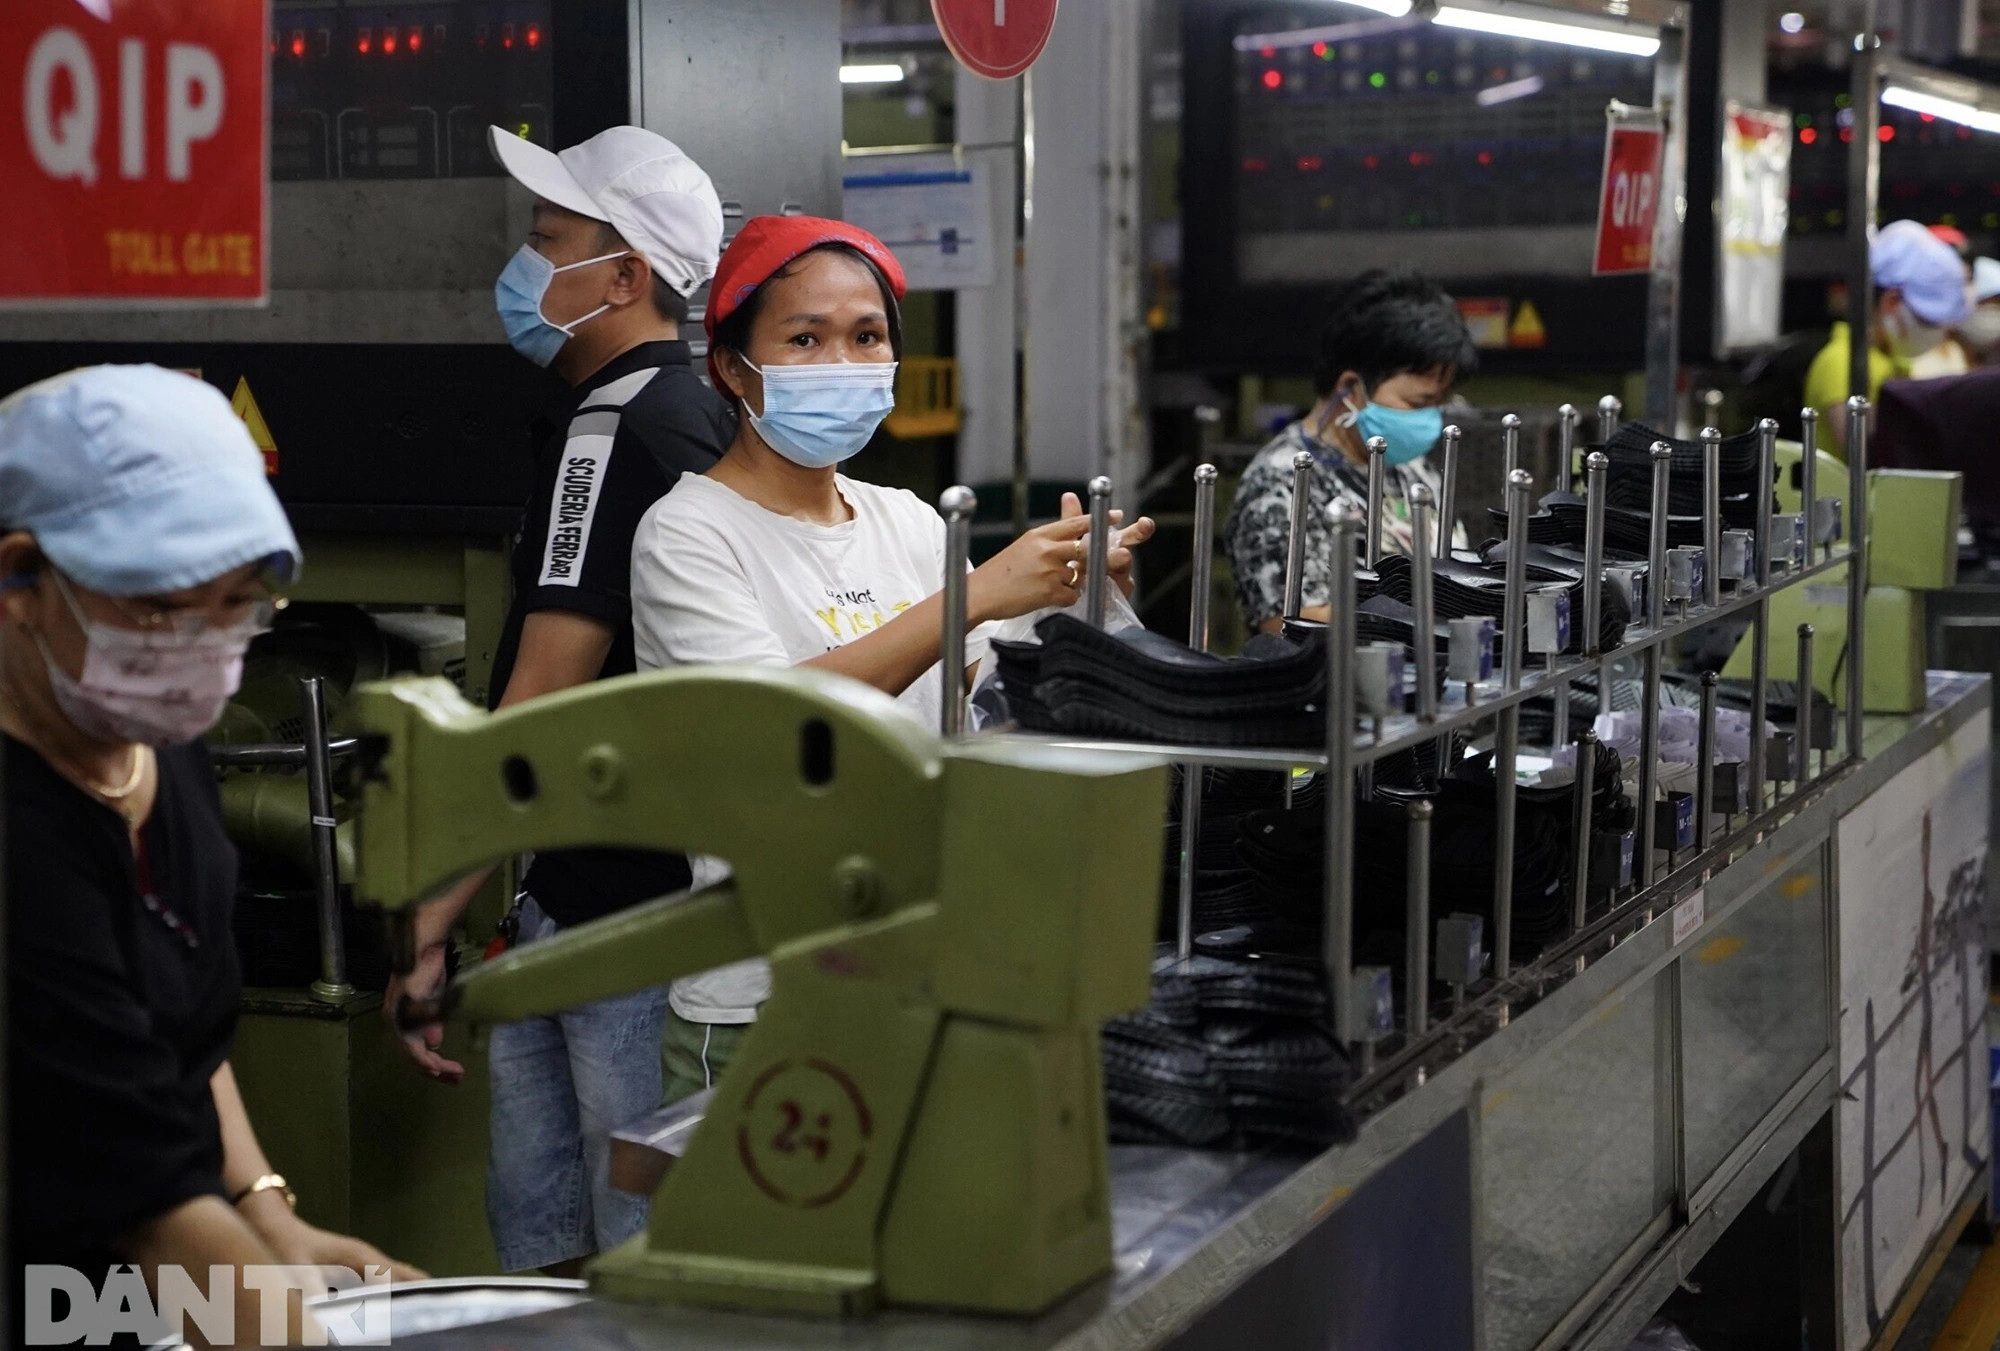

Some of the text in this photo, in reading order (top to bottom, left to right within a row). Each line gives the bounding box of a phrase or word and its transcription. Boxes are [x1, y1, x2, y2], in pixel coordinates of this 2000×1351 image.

[24, 26, 225, 188] QIP
[1613, 171, 1652, 228] QIP
[183, 231, 252, 276] GATE
[547, 457, 596, 578] SCUDERIA FERRARI
